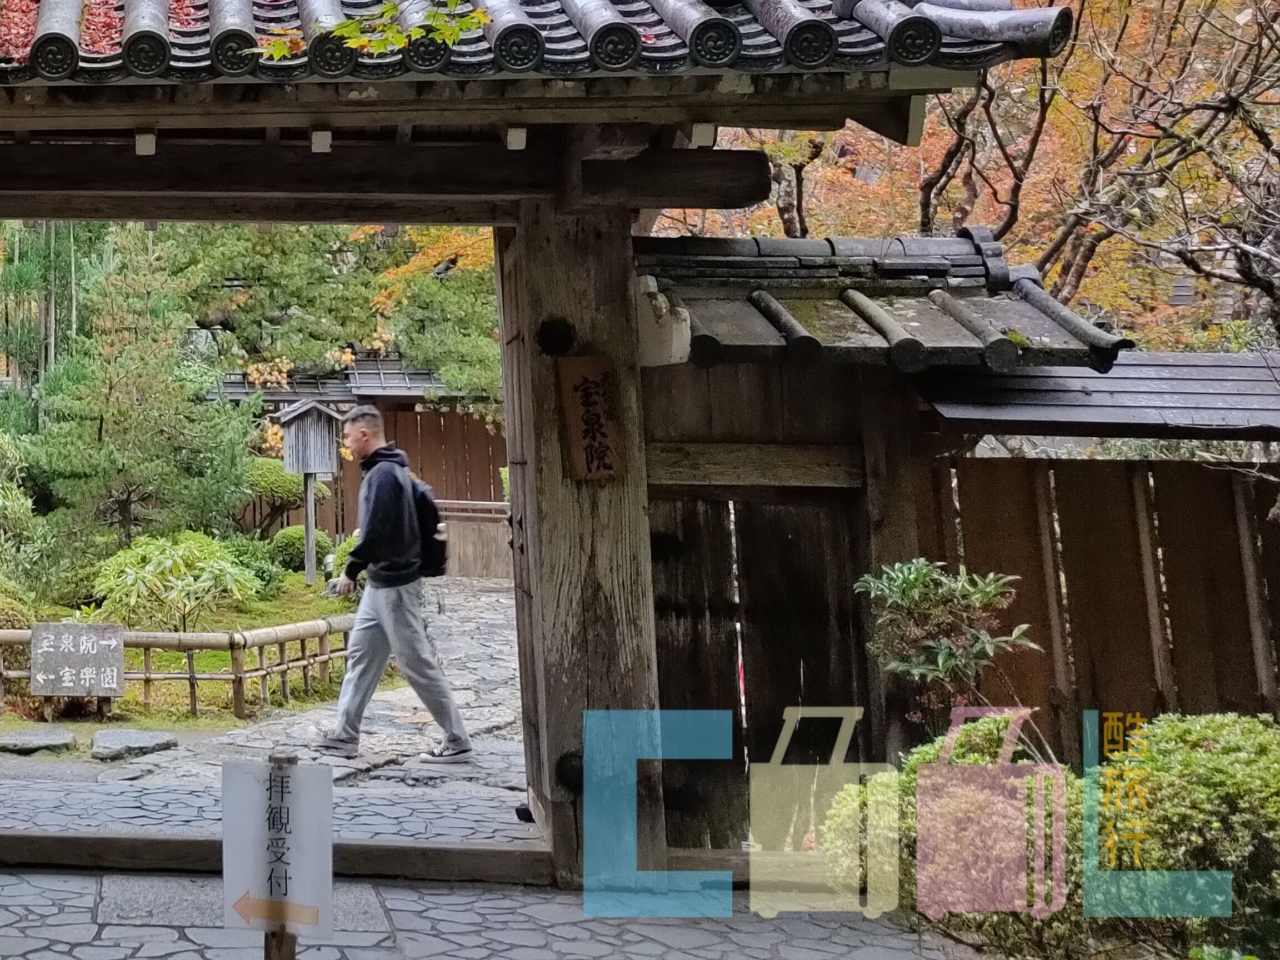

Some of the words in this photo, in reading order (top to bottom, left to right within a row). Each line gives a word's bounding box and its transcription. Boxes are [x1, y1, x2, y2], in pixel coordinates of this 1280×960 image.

[37, 632, 97, 654] 宝泉院
[60, 666, 118, 688] 宝楽園
[265, 772, 293, 897] 拝観受付
